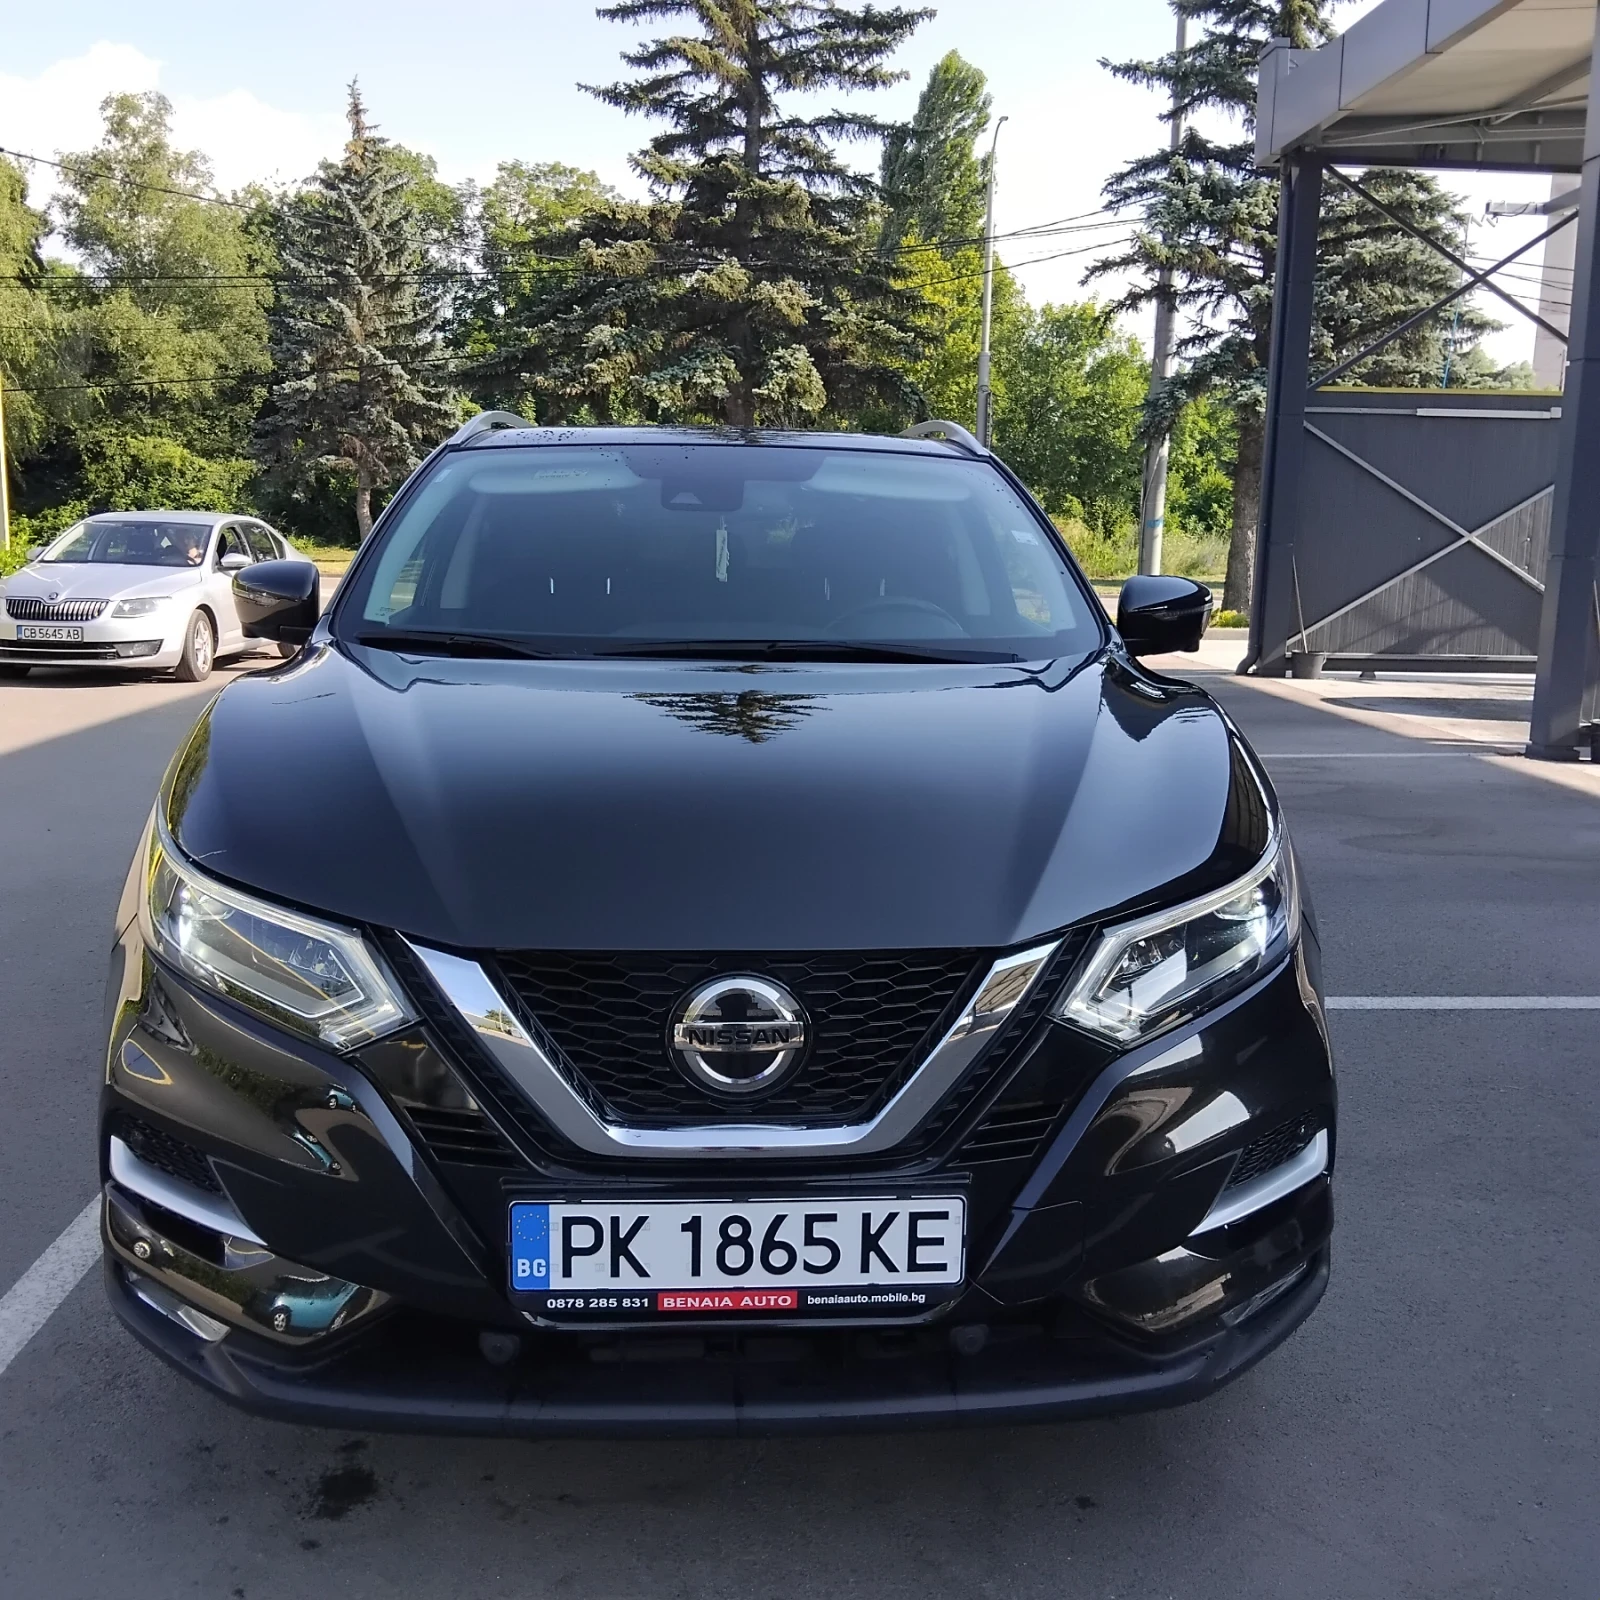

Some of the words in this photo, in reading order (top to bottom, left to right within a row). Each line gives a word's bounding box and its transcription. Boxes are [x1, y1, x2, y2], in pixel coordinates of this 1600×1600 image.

[23, 628, 36, 639] CB
[38, 628, 63, 640] 5645
[67, 629, 80, 640] AB
[688, 1028, 790, 1046] NISSAN
[561, 1215, 652, 1279] PK
[680, 1212, 842, 1278] 1865
[859, 1210, 950, 1274] KE
[516, 1258, 547, 1278] BG
[546, 1298, 585, 1309] 0878
[588, 1298, 618, 1309] 285
[621, 1298, 650, 1309] 831
[662, 1296, 734, 1309] BENAIA
[740, 1294, 792, 1307] AUTO
[807, 1292, 926, 1305] benaiaauto.mobile.bg
